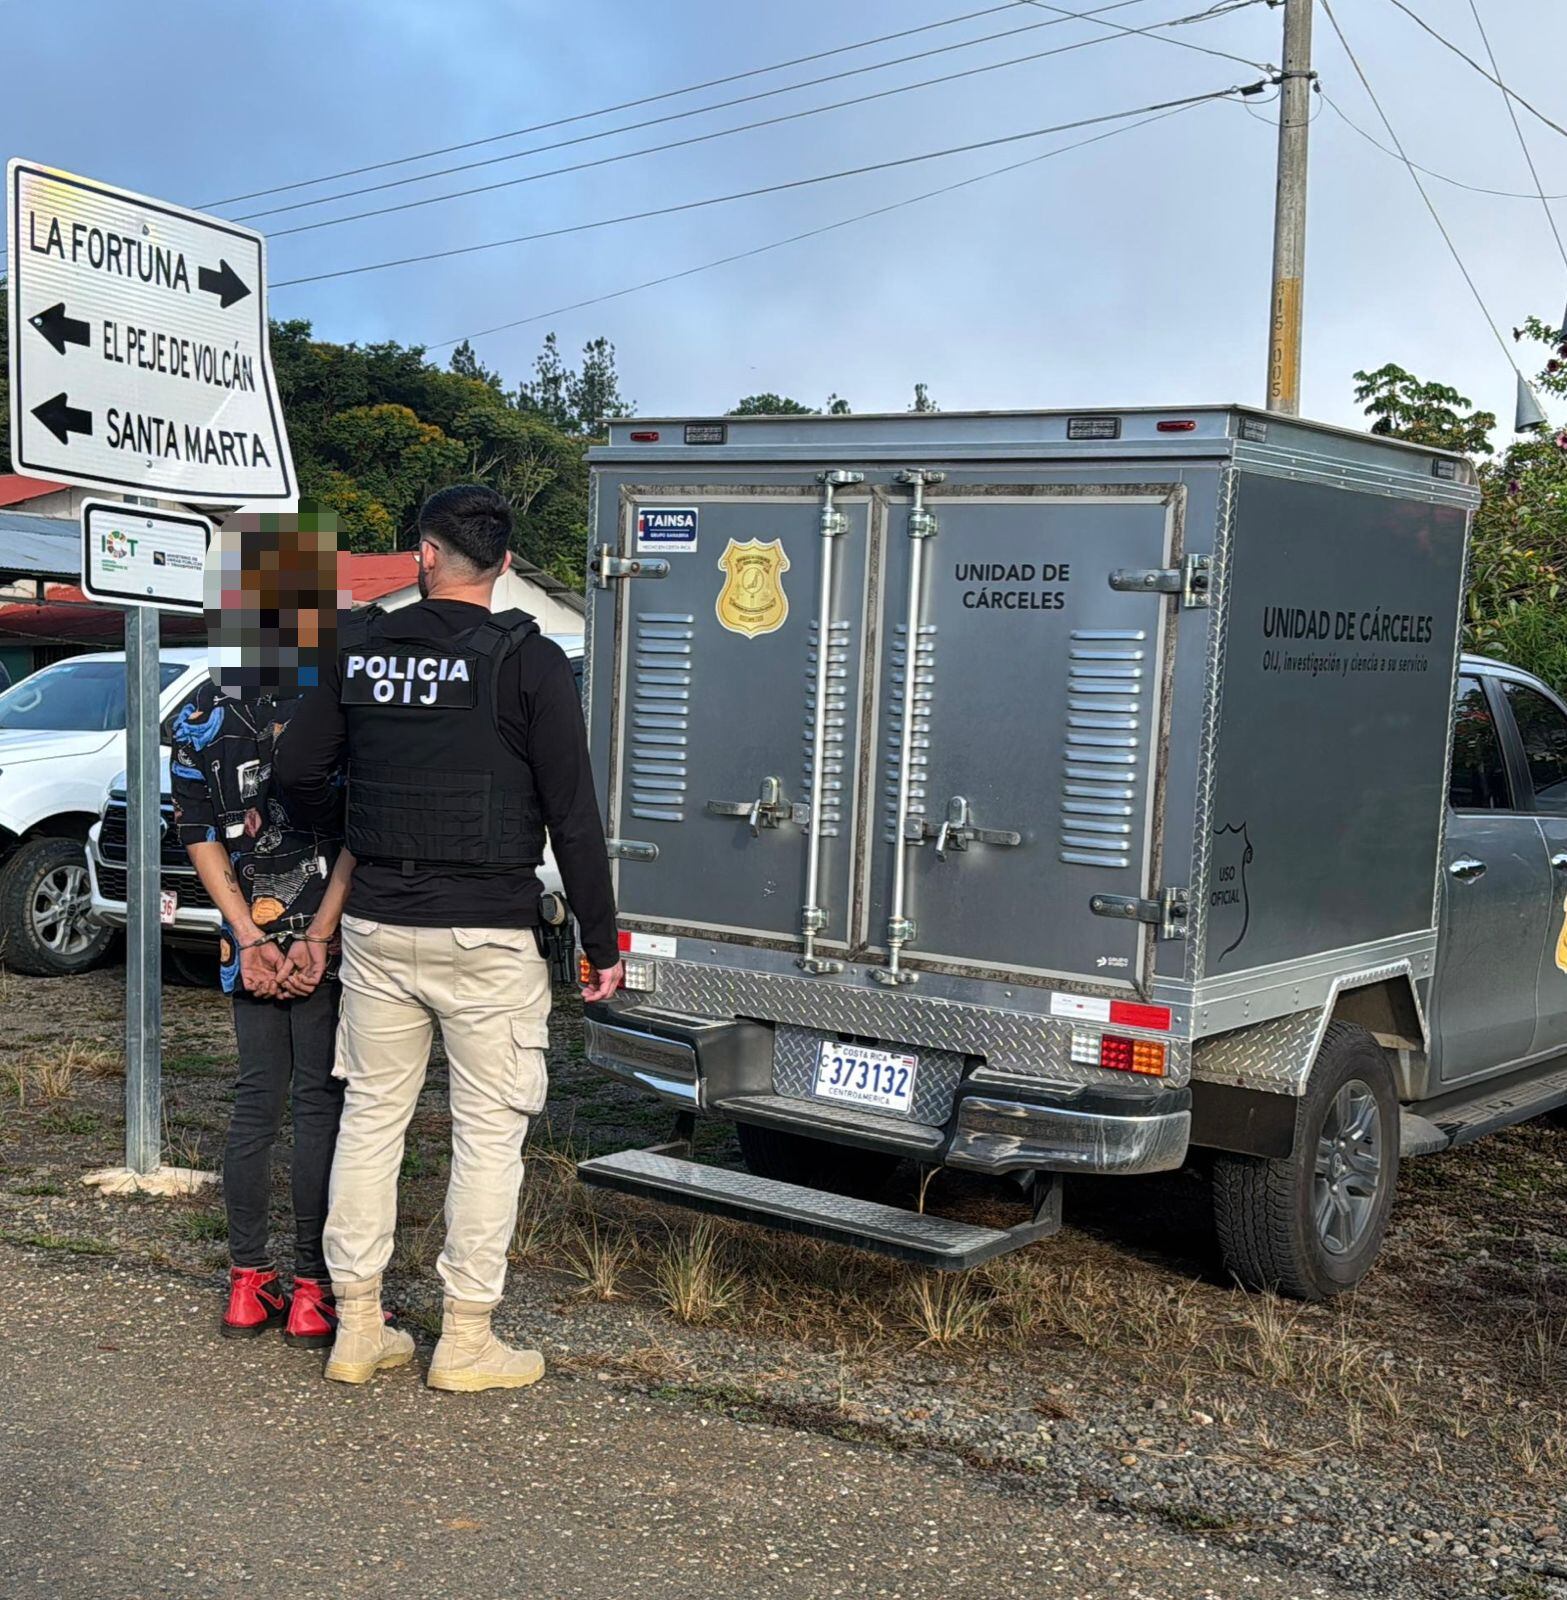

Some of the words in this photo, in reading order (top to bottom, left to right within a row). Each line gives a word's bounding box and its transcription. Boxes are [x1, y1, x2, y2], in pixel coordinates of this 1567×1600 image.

[30, 211, 65, 259] LA
[72, 222, 191, 293] FORTUNA
[104, 321, 124, 363] EL
[128, 326, 167, 373] PEJE
[171, 337, 190, 379] DE
[193, 340, 256, 393] VOLCÁN
[107, 408, 180, 460] SANTA
[185, 424, 272, 468] MARTA
[646, 514, 694, 527] TAINSA
[101, 530, 139, 560] ICT
[955, 564, 1036, 581] UNIDAD
[1042, 564, 1070, 581] DE
[962, 587, 1065, 610] CÁRCELES
[1263, 606, 1330, 639] UNIDAD
[1335, 612, 1356, 641] DE
[1360, 606, 1433, 644] CÁRCELES
[347, 656, 470, 682] POLICIA
[1263, 650, 1281, 674] OIJ,
[1284, 651, 1340, 677] investigación
[1343, 659, 1349, 677] y
[1351, 653, 1378, 672] ciencia
[1380, 659, 1385, 671] a
[1388, 659, 1396, 671] su
[1399, 654, 1428, 672] servicio
[1219, 866, 1236, 882] USO
[1211, 889, 1240, 907] OFICIAL
[843, 1048, 868, 1059] COSTA
[870, 1051, 888, 1062] RICA
[830, 1057, 909, 1097] 373132
[828, 1087, 890, 1105] CENTROAMERICA
